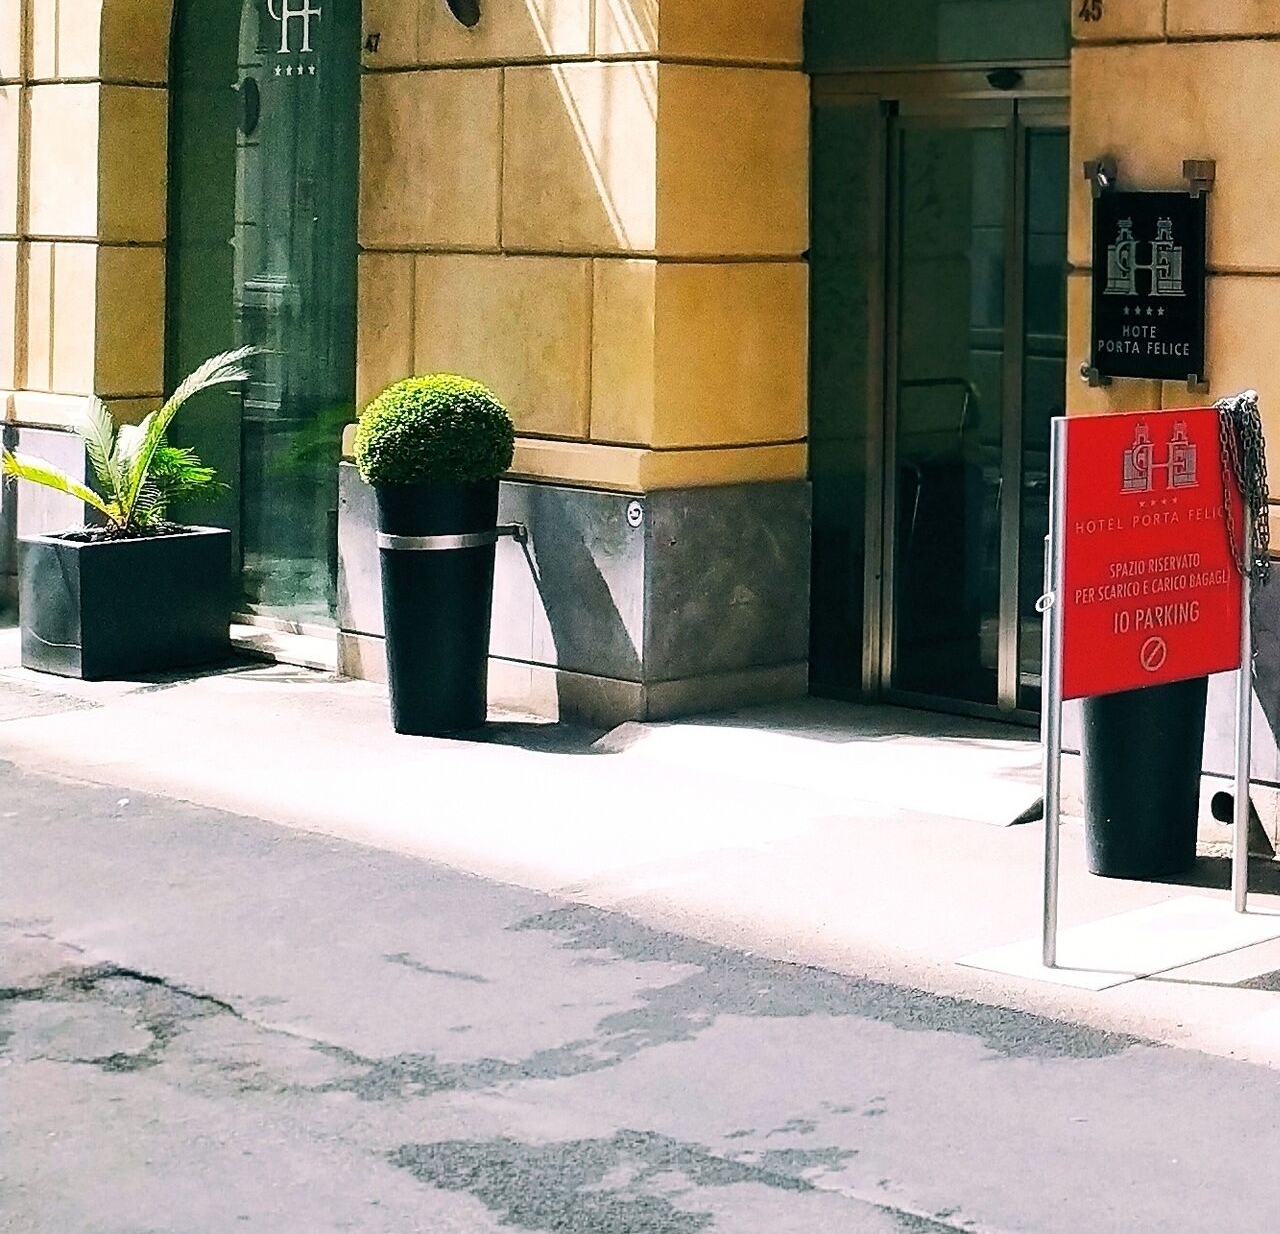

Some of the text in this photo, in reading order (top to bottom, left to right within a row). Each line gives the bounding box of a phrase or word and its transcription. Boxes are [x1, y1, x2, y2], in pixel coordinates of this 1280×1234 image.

[1098, 340, 1190, 356] PORTA FELICE
[1075, 518, 1123, 534] HOTEL
[1132, 511, 1179, 528] PORTA
[1109, 552, 1200, 578] SPAZIO RISERVATO
[1075, 587, 1095, 604] PER
[1098, 580, 1140, 601] SCARICO
[1143, 580, 1149, 595] E
[1151, 573, 1187, 593] CARICO
[1135, 600, 1200, 631] PARKING
